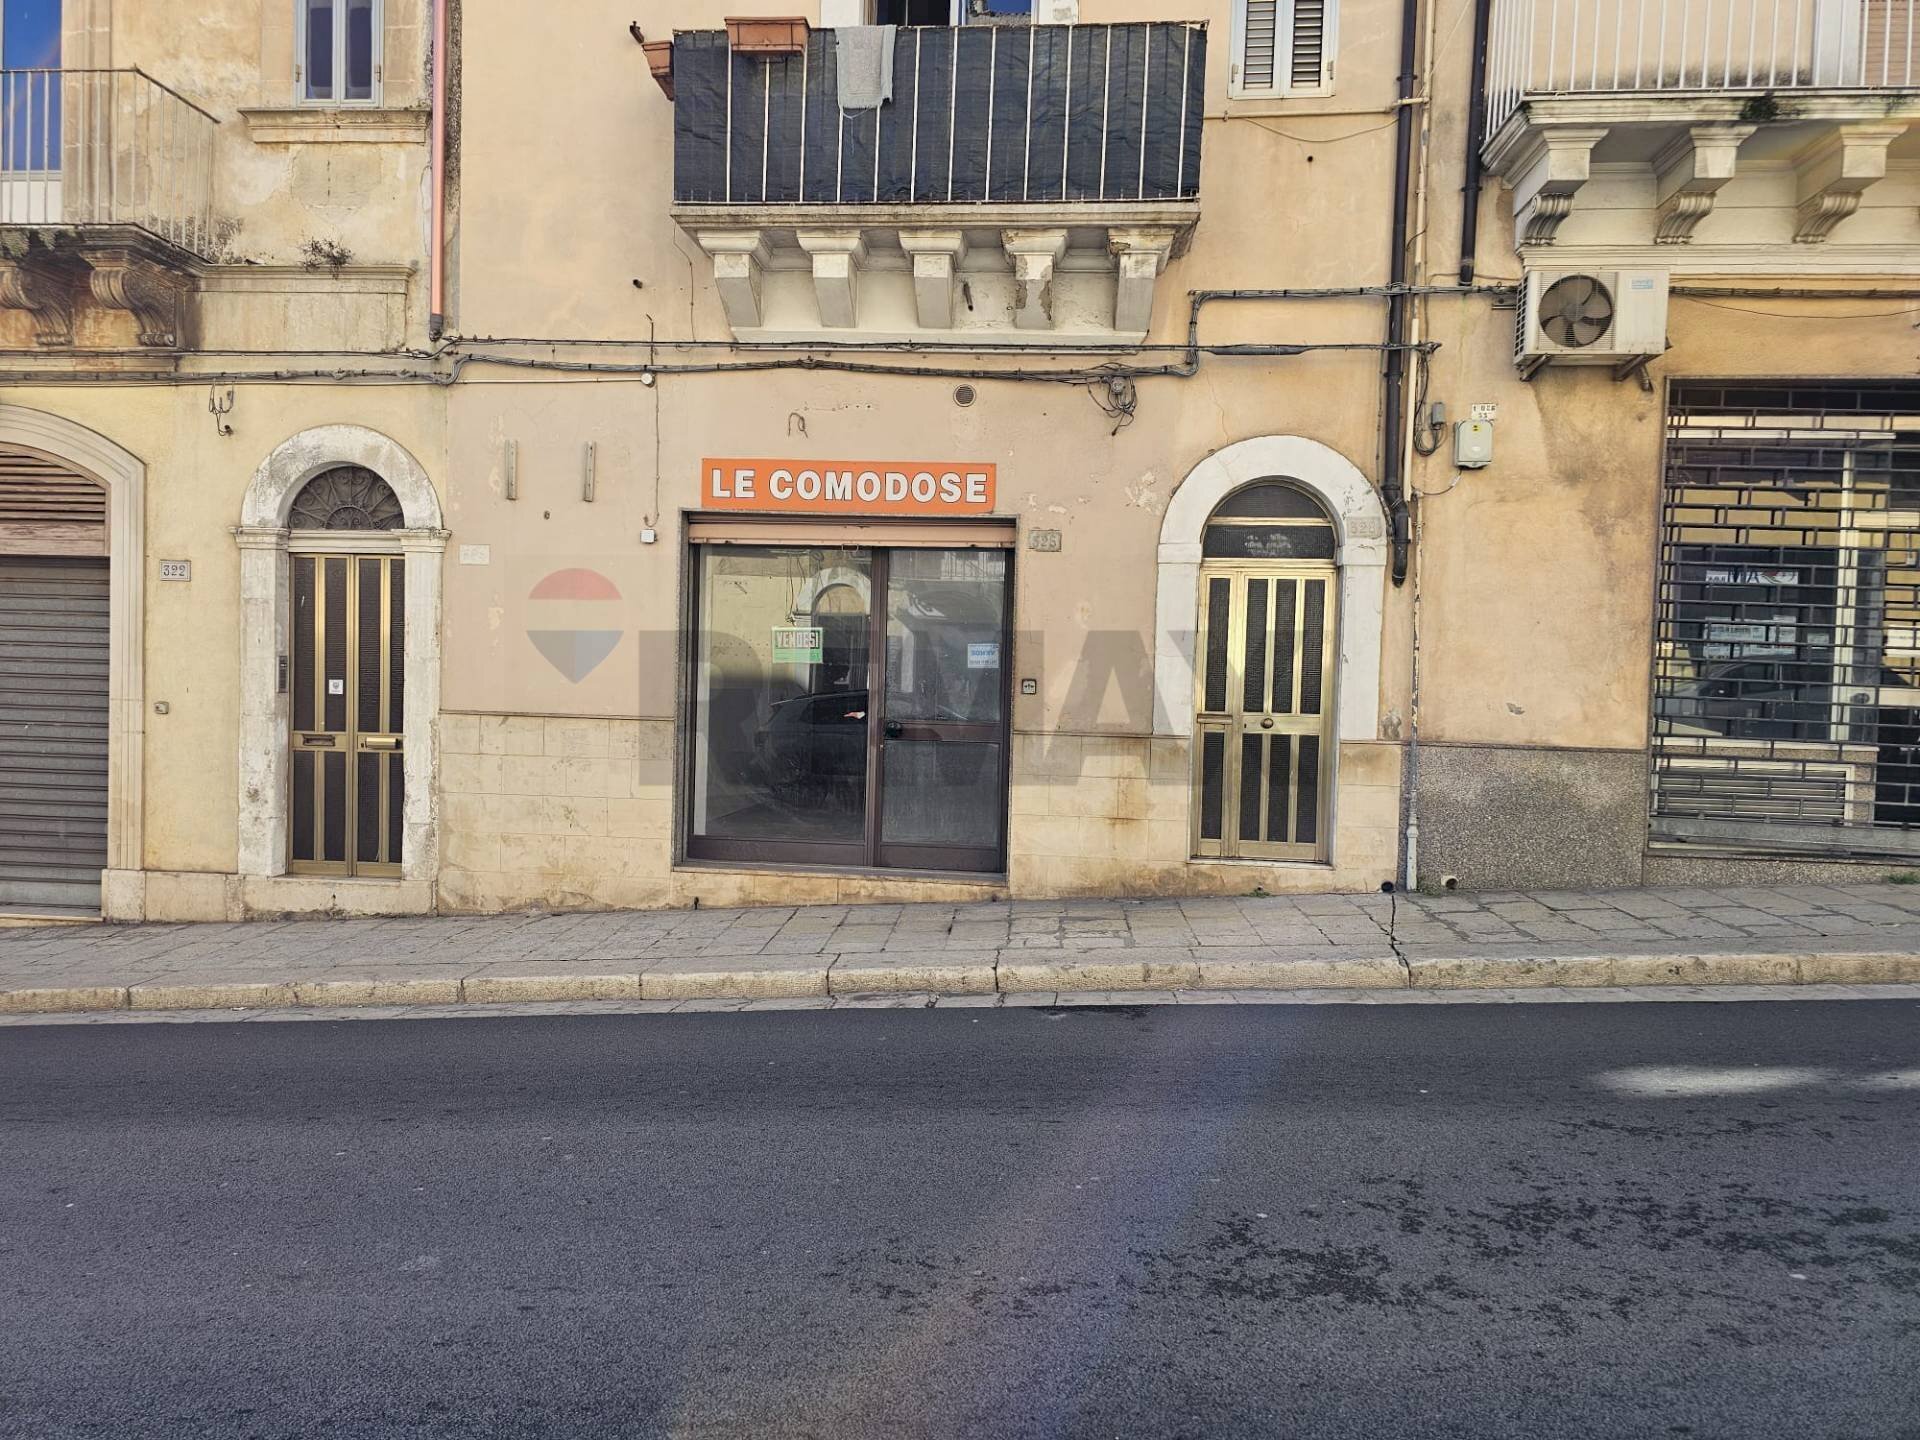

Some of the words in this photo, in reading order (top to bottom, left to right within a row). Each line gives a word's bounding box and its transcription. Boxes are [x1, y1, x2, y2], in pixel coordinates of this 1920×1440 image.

[712, 468, 756, 499] LE
[768, 469, 988, 504] COMODOSE
[163, 564, 186, 577] 322
[776, 631, 819, 648] VENDESI
